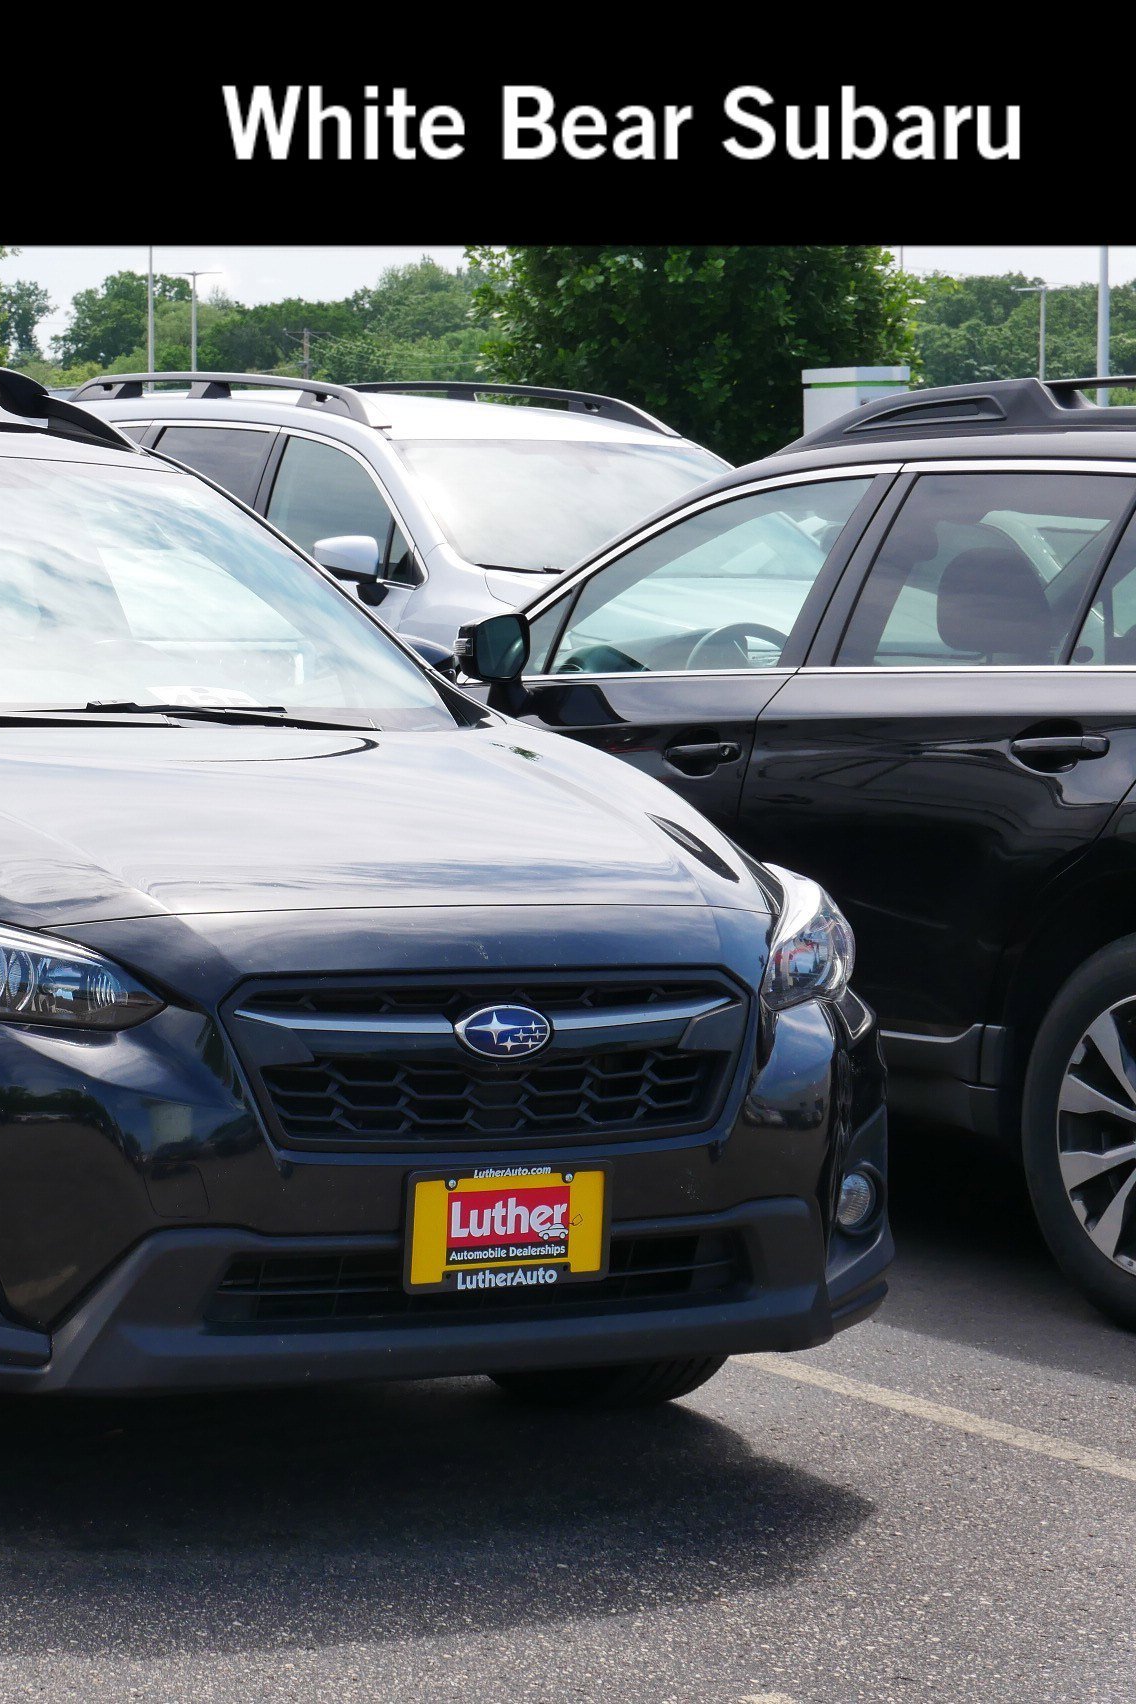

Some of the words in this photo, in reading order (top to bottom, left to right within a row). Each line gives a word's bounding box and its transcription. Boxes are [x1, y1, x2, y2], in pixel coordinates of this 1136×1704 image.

[473, 1166, 552, 1179] LutherAuto.com
[450, 1197, 568, 1238] Luther
[449, 1247, 507, 1261] Automobile
[509, 1243, 566, 1257] Dealerships
[456, 1266, 558, 1290] LutherAuto
